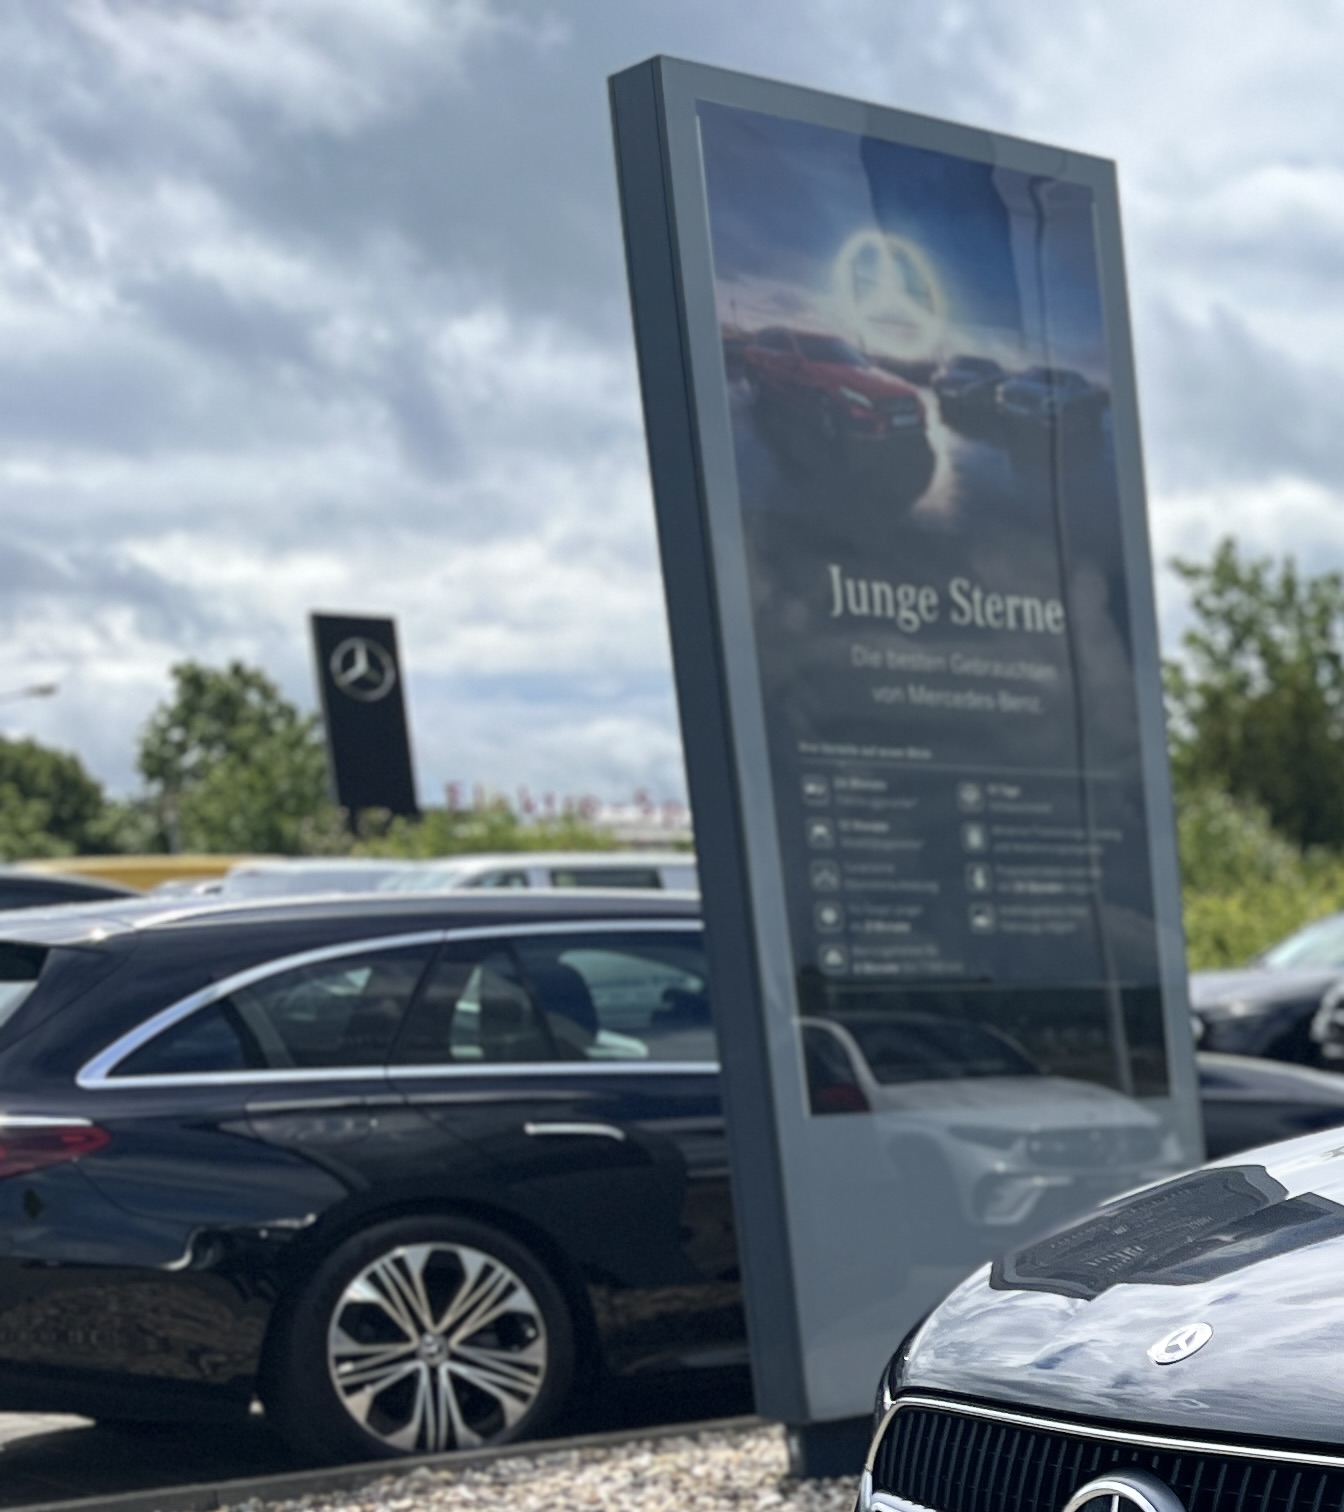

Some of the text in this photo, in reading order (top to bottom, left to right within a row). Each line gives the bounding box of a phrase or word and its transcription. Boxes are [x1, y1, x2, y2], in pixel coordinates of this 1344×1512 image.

[827, 564, 1066, 636] Junge Sterne
[850, 643, 882, 669] Die
